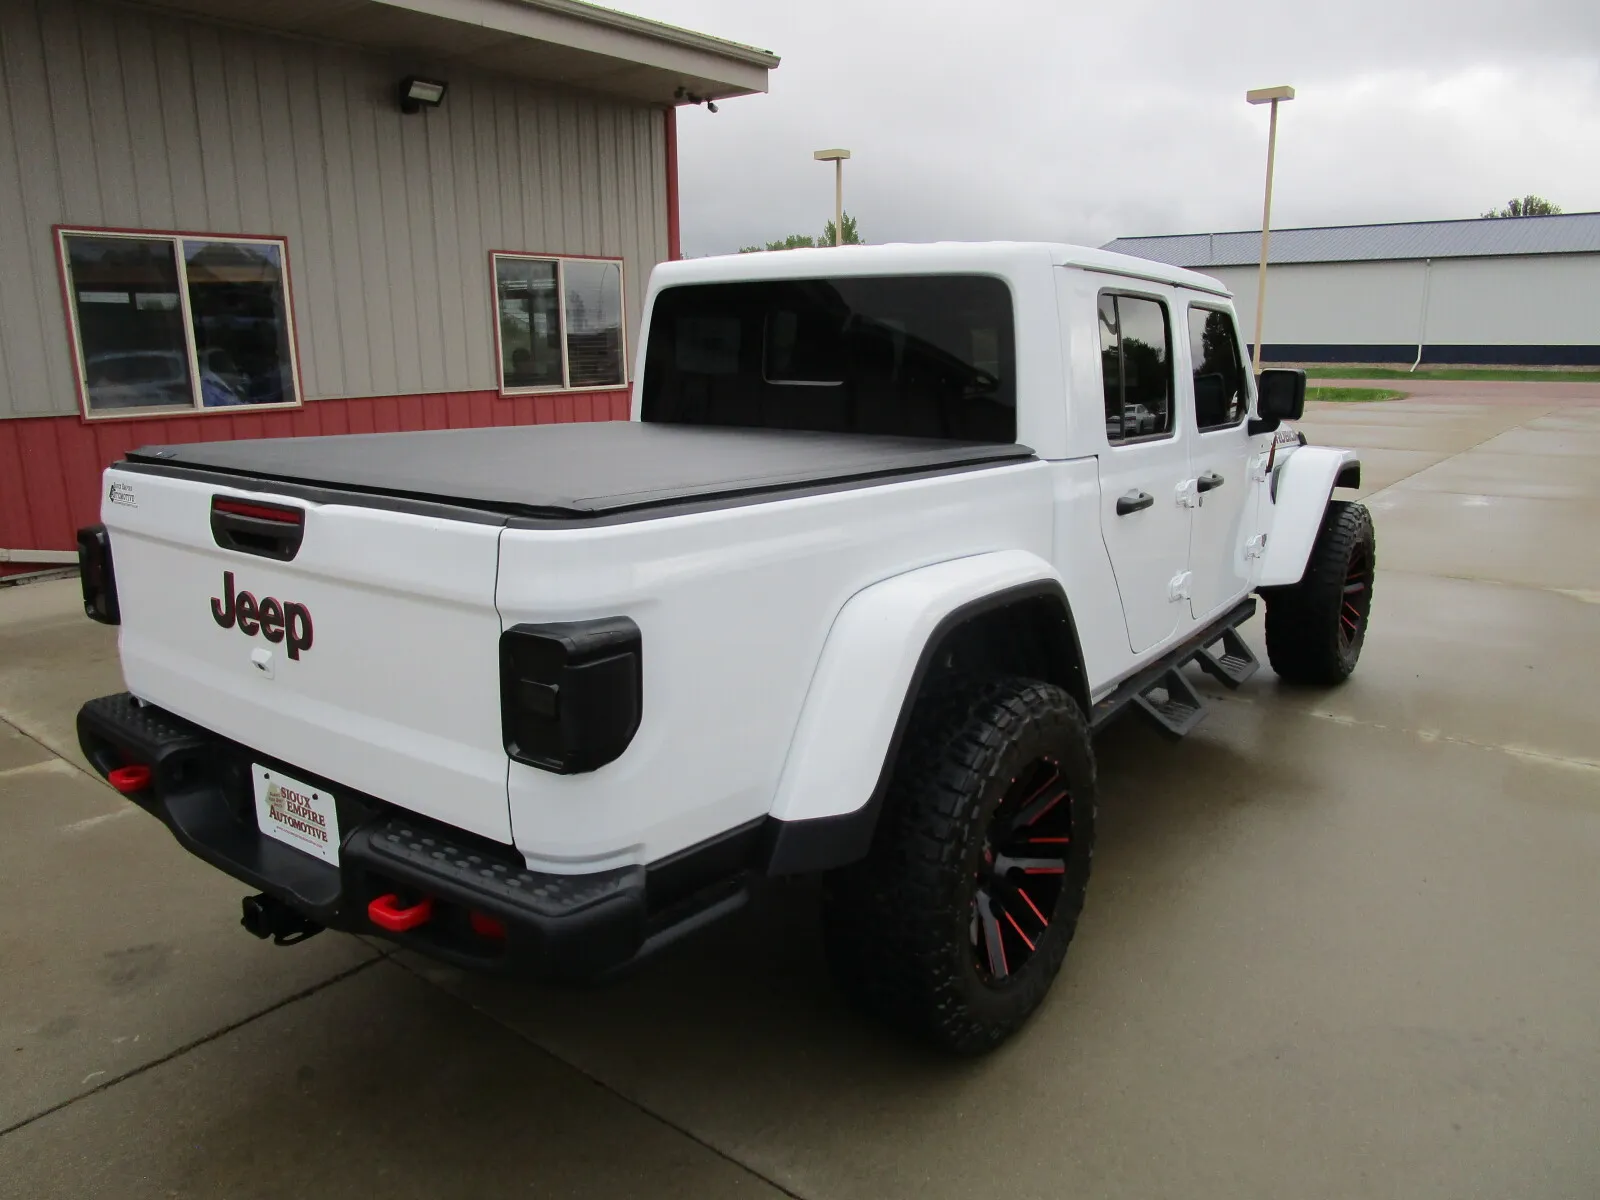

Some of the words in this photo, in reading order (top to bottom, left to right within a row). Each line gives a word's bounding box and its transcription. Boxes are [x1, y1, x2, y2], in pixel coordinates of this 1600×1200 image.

[210, 570, 313, 661] Jeep
[280, 787, 312, 809] SIOUX
[286, 800, 326, 827] EMPIRE
